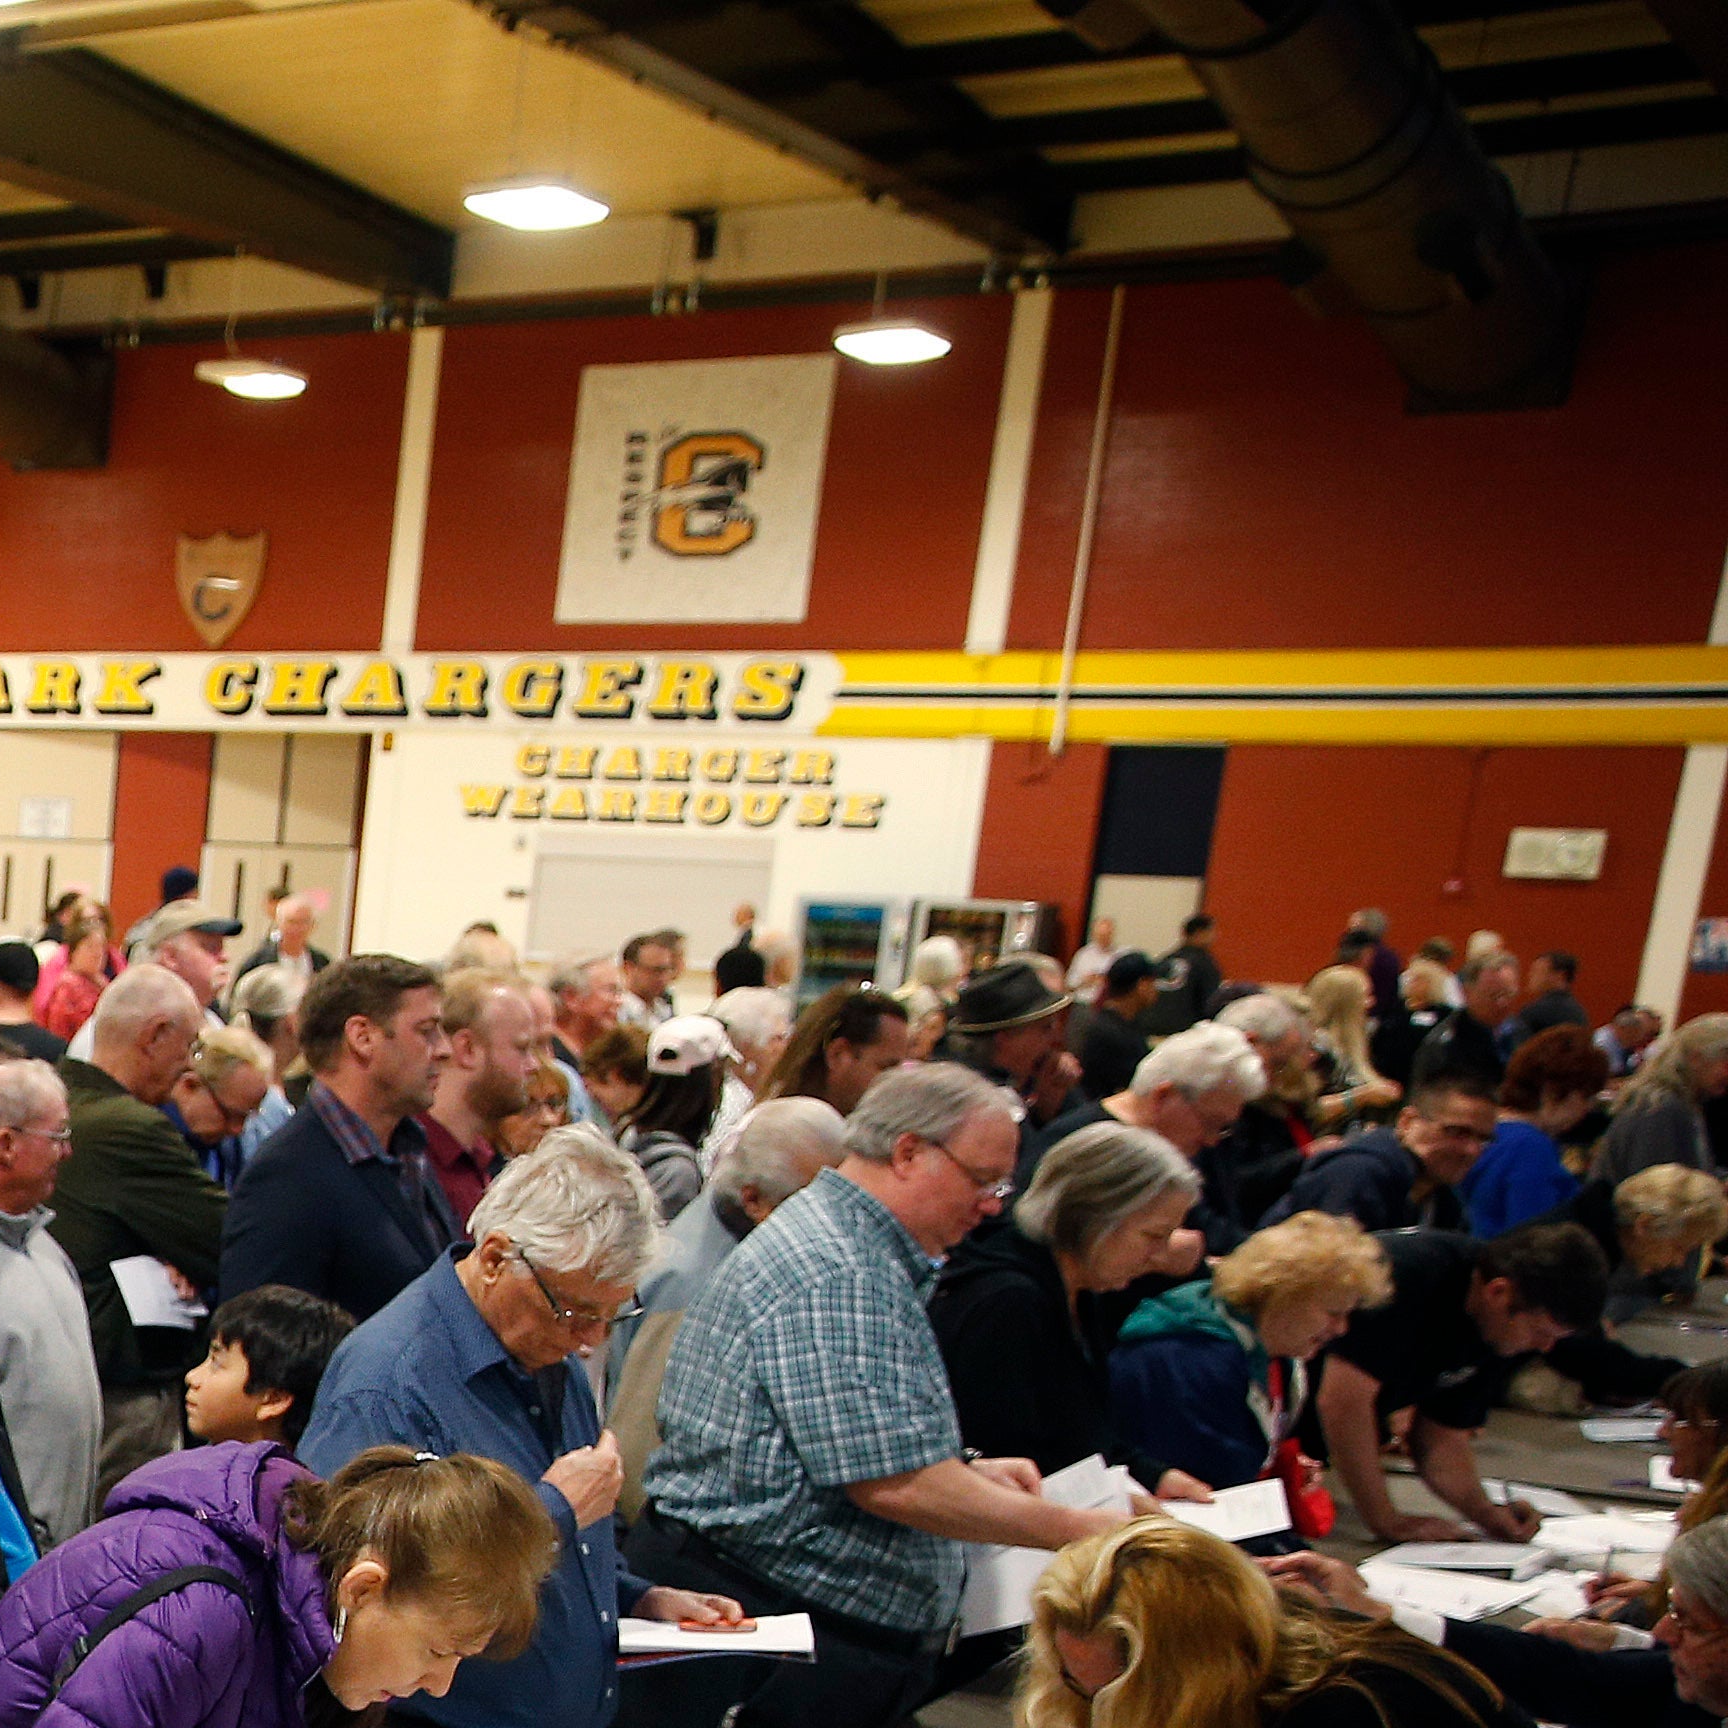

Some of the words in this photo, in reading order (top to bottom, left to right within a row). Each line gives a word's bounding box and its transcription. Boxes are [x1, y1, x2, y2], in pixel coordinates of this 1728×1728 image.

[202, 658, 805, 722] CHARGERS
[515, 743, 838, 786] CHARGER
[459, 782, 888, 830] WEARHOUSE
